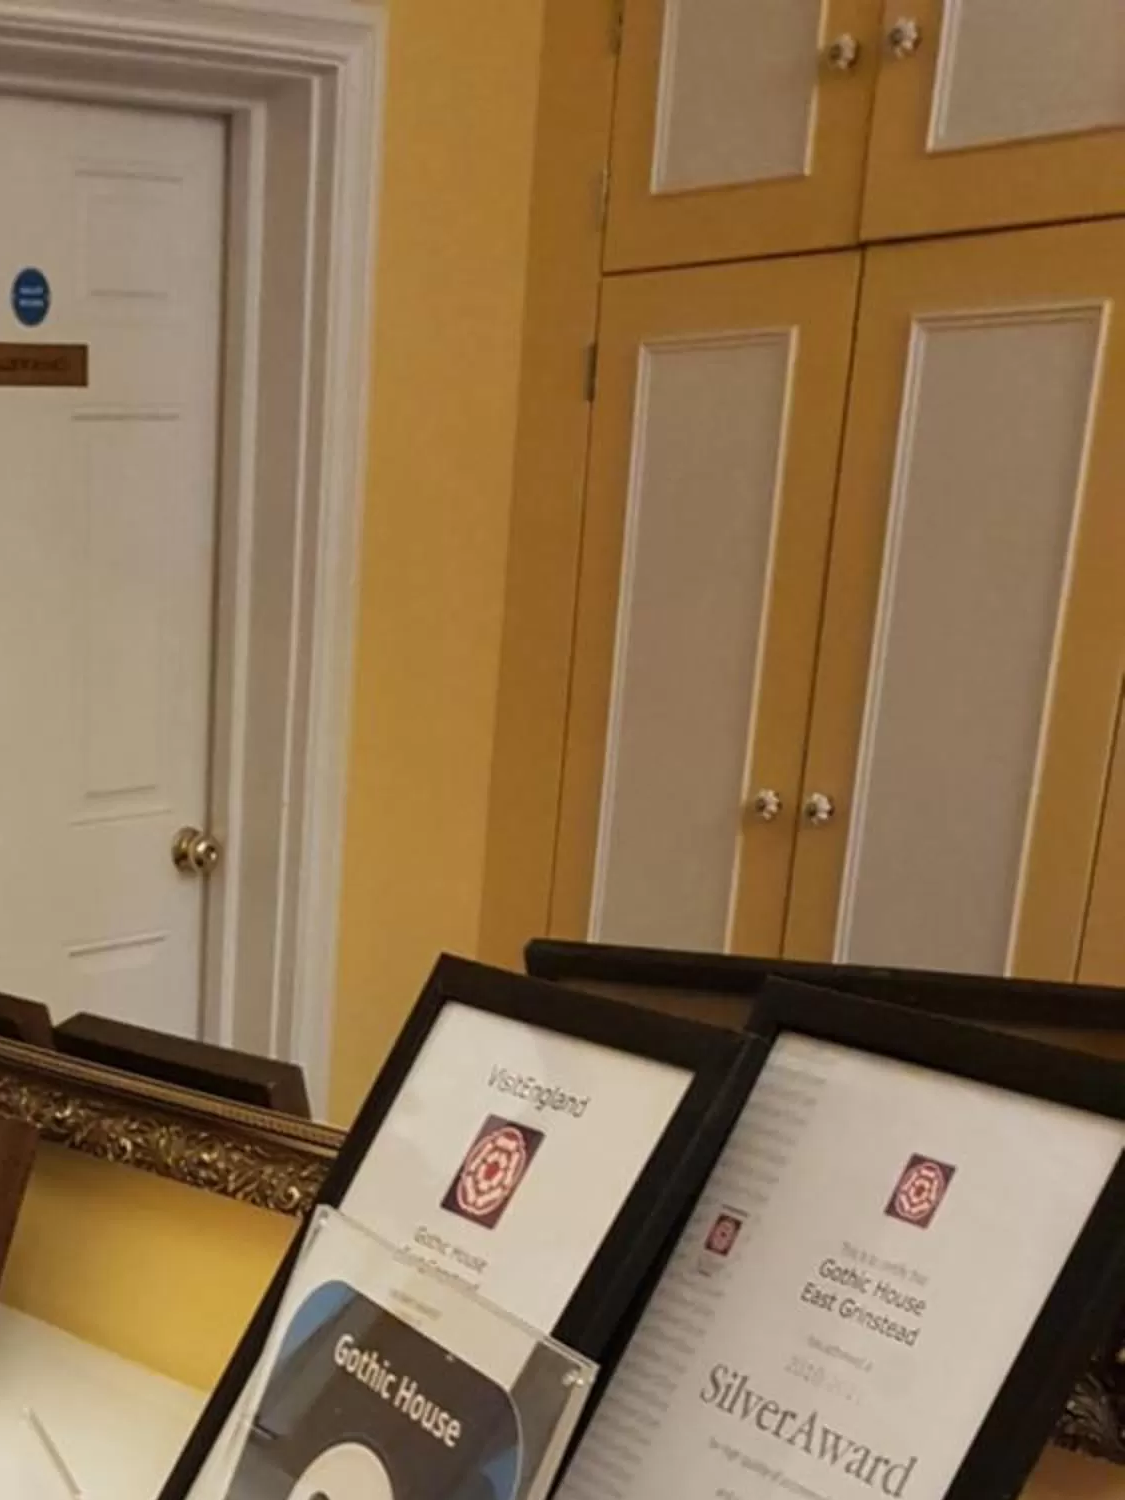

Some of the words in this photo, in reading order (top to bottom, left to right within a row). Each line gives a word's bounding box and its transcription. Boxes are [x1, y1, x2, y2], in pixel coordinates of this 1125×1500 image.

[487, 1063, 591, 1118] VisitEngland
[801, 1281, 836, 1312] East
[819, 1258, 871, 1294] Gothic
[873, 1281, 927, 1316] House
[334, 1333, 396, 1399] Gothic
[393, 1375, 461, 1448] House
